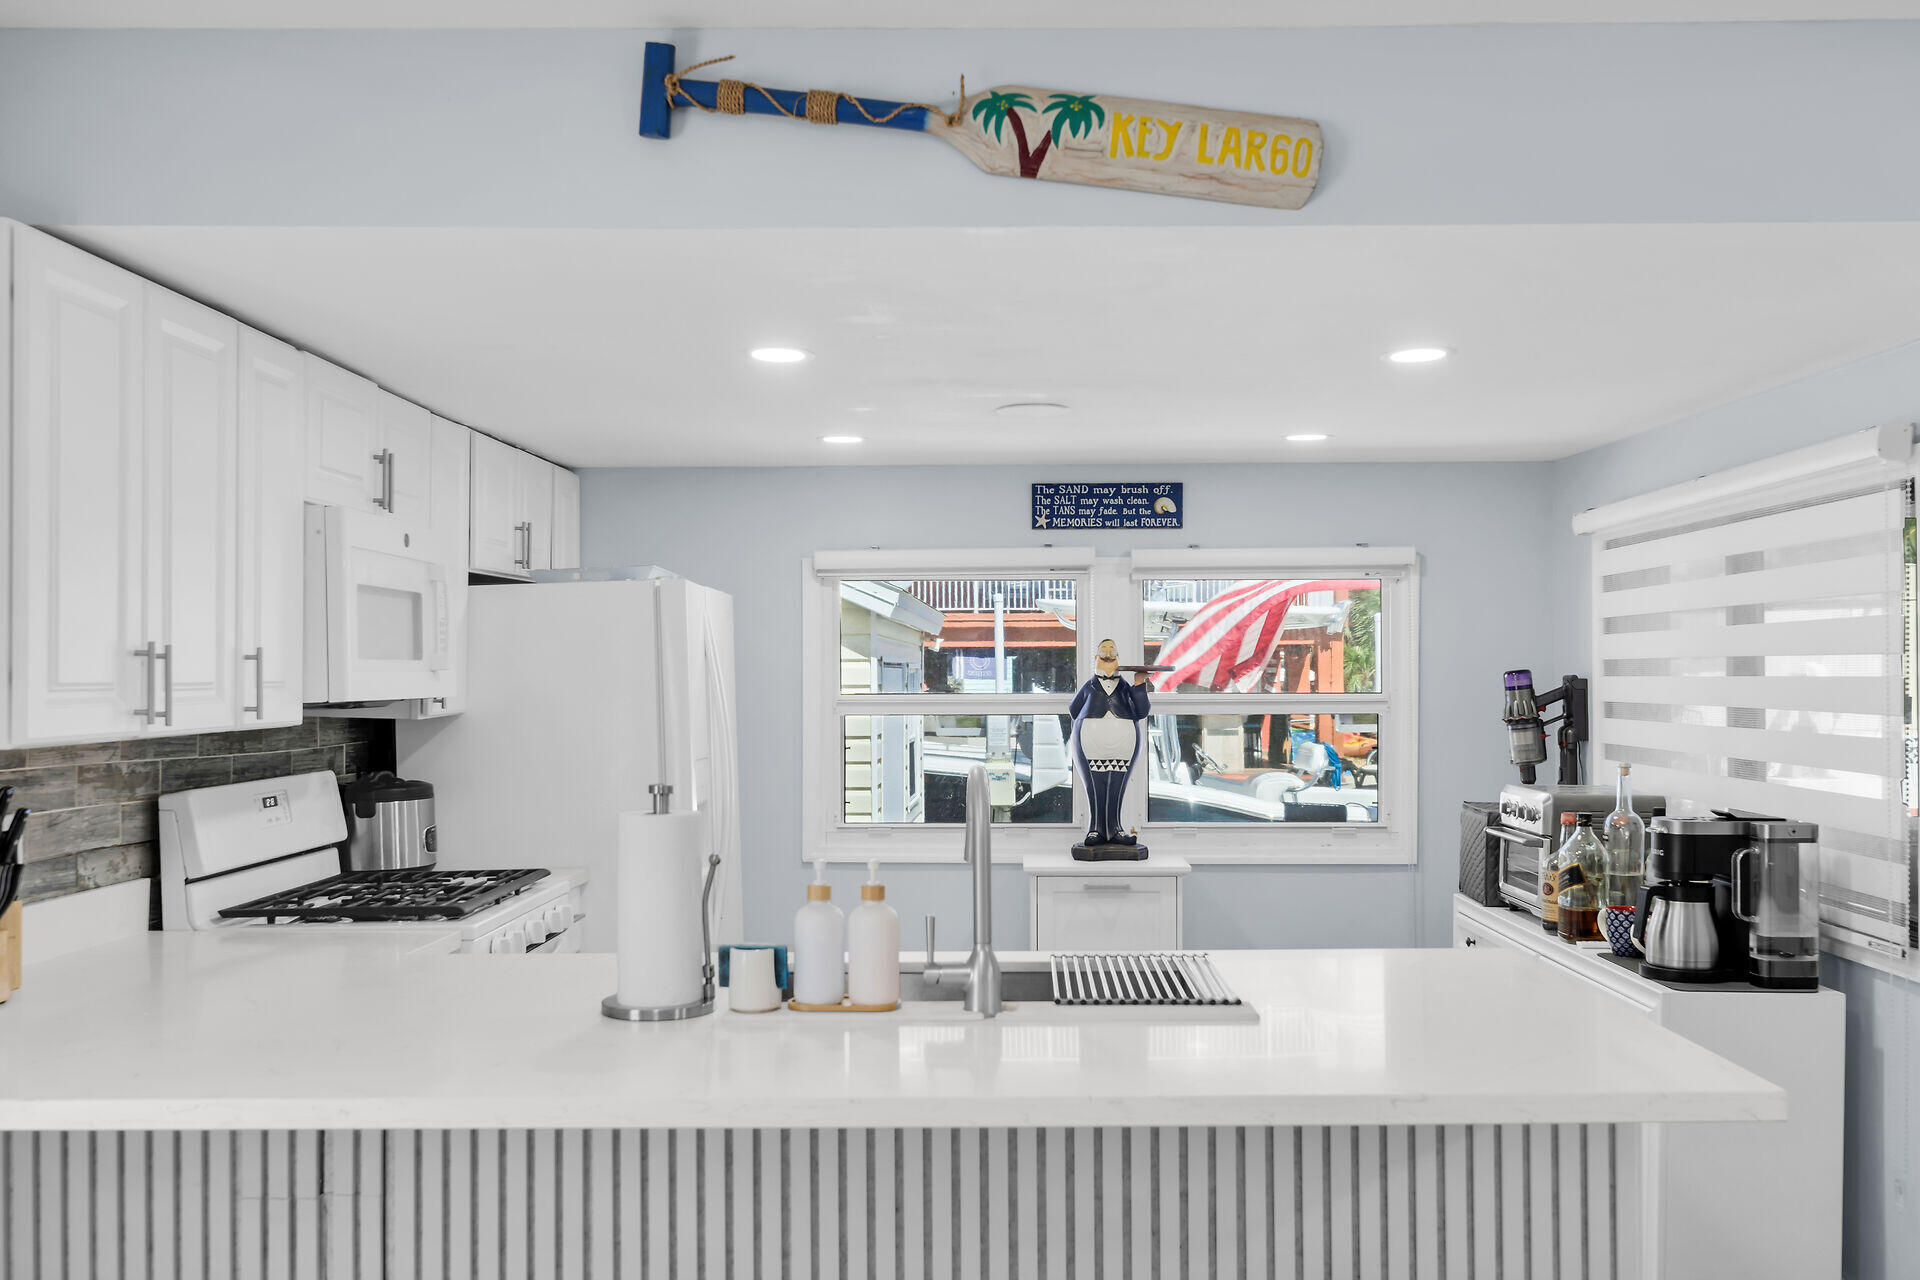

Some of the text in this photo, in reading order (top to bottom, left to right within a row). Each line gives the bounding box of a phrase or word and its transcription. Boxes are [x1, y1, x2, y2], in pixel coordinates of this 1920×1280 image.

[1109, 111, 1184, 161] KEY
[1035, 485, 1173, 497] The SAND may brush off.
[1035, 495, 1150, 507] The SALT may wash clean.
[1035, 505, 1050, 515] The
[1052, 505, 1075, 515] TANS
[1078, 508, 1096, 517] may
[1052, 517, 1181, 527] MEMORIES will last FOREVER.
